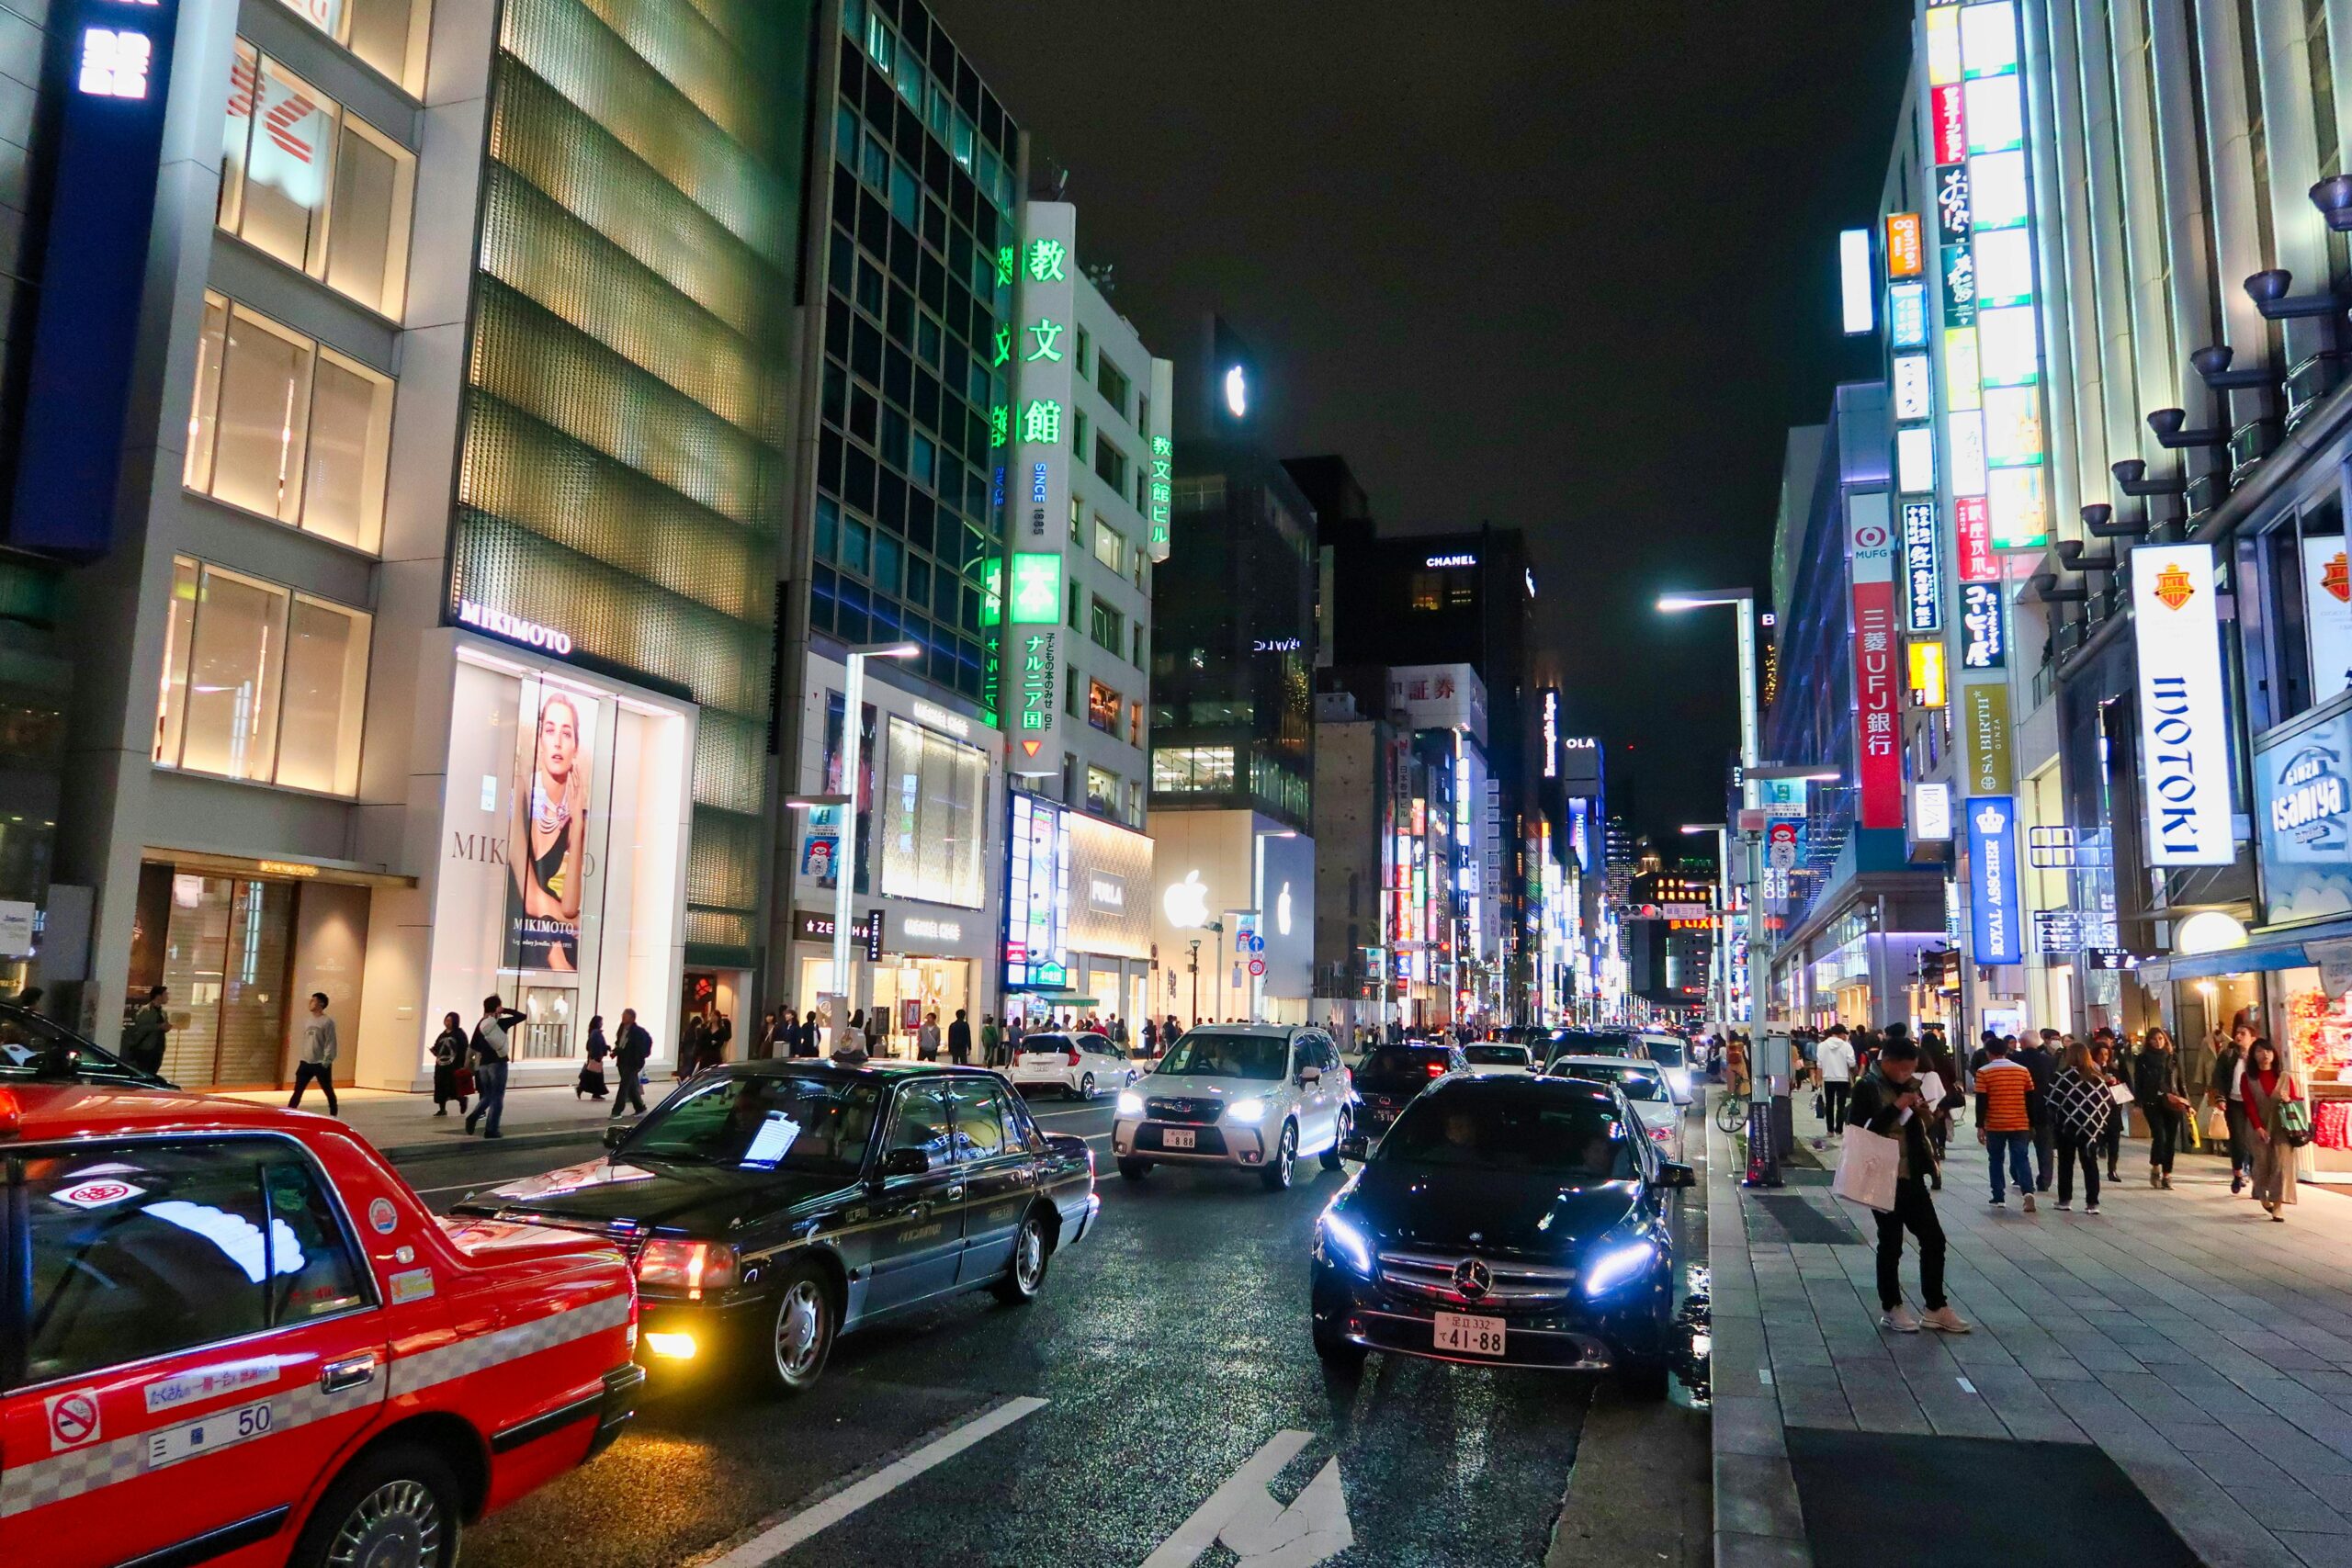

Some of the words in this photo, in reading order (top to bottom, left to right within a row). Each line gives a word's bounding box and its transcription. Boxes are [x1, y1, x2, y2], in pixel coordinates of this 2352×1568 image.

[1902, 219, 1916, 270] genten
[1023, 237, 1066, 444] 教文館
[1034, 463, 1046, 502] SINCE
[1152, 434, 1172, 544] 教文館ビル
[1034, 508, 1045, 536] 1885
[1426, 555, 1476, 568] CHANEL
[1855, 549, 1888, 559] MUFG
[1019, 566, 1056, 613] 本
[459, 599, 571, 655] MIKIMOTO
[1965, 585, 1991, 667] コーヒー屋
[1023, 636, 1045, 728] ナルニア国
[1044, 632, 1055, 709] 子どもの本のみせ
[1863, 609, 1892, 756] 三菱UFJ銀行
[1044, 713, 1053, 732] 6F
[1977, 698, 1993, 750] BIRTH
[1993, 718, 2002, 750] GINZA
[1981, 753, 1993, 773] SA
[2285, 760, 2320, 786] GINZA
[1985, 840, 2004, 907] ASSCHER
[513, 918, 574, 935] MIKIMOTO
[1989, 909, 2006, 956] ROYAL
[1252, 964, 1261, 972] 50
[1450, 1328, 1500, 1352] 41-88
[1473, 1319, 1490, 1330] 332
[239, 1405, 270, 1436] 50
